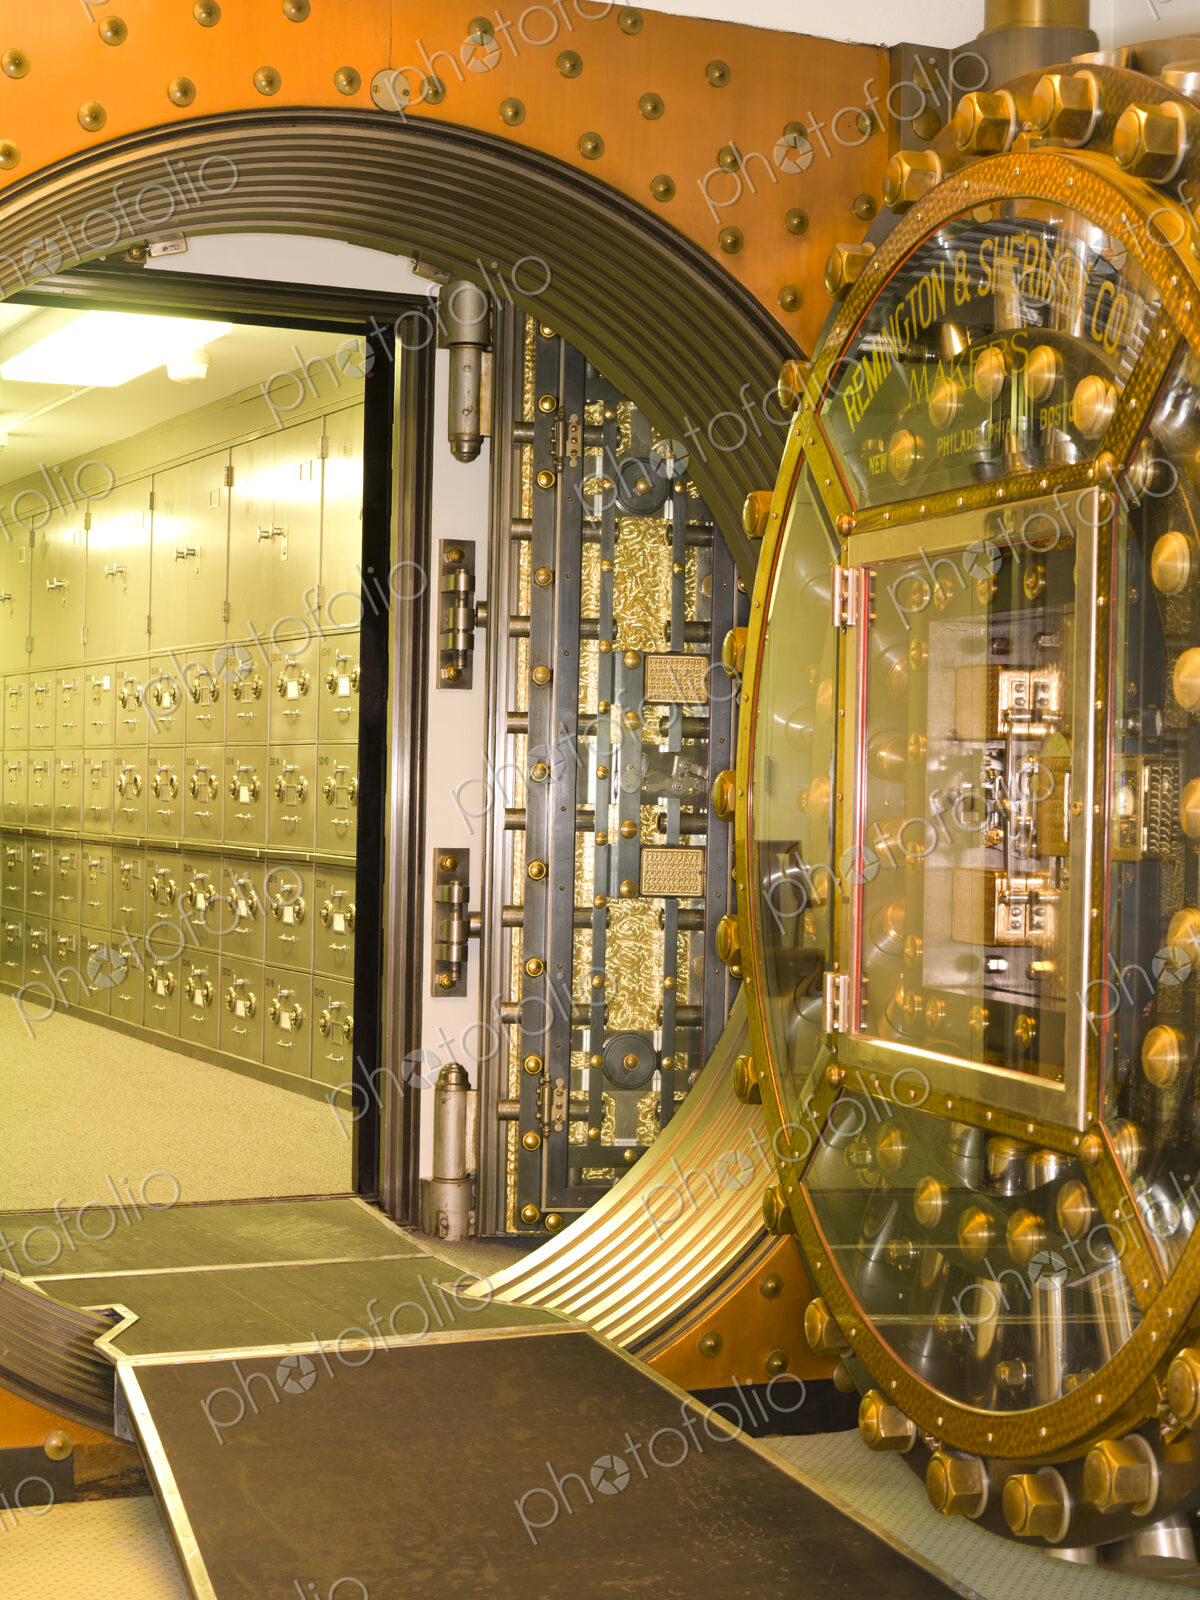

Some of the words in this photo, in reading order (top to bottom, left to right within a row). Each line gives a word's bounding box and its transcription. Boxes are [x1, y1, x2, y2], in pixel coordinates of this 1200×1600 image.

[843, 261, 946, 434] REMINGTON
[953, 249, 972, 307] &
[908, 331, 1029, 408] MAKERS
[868, 451, 888, 476] NEW
[1040, 397, 1083, 431] BOSTO
